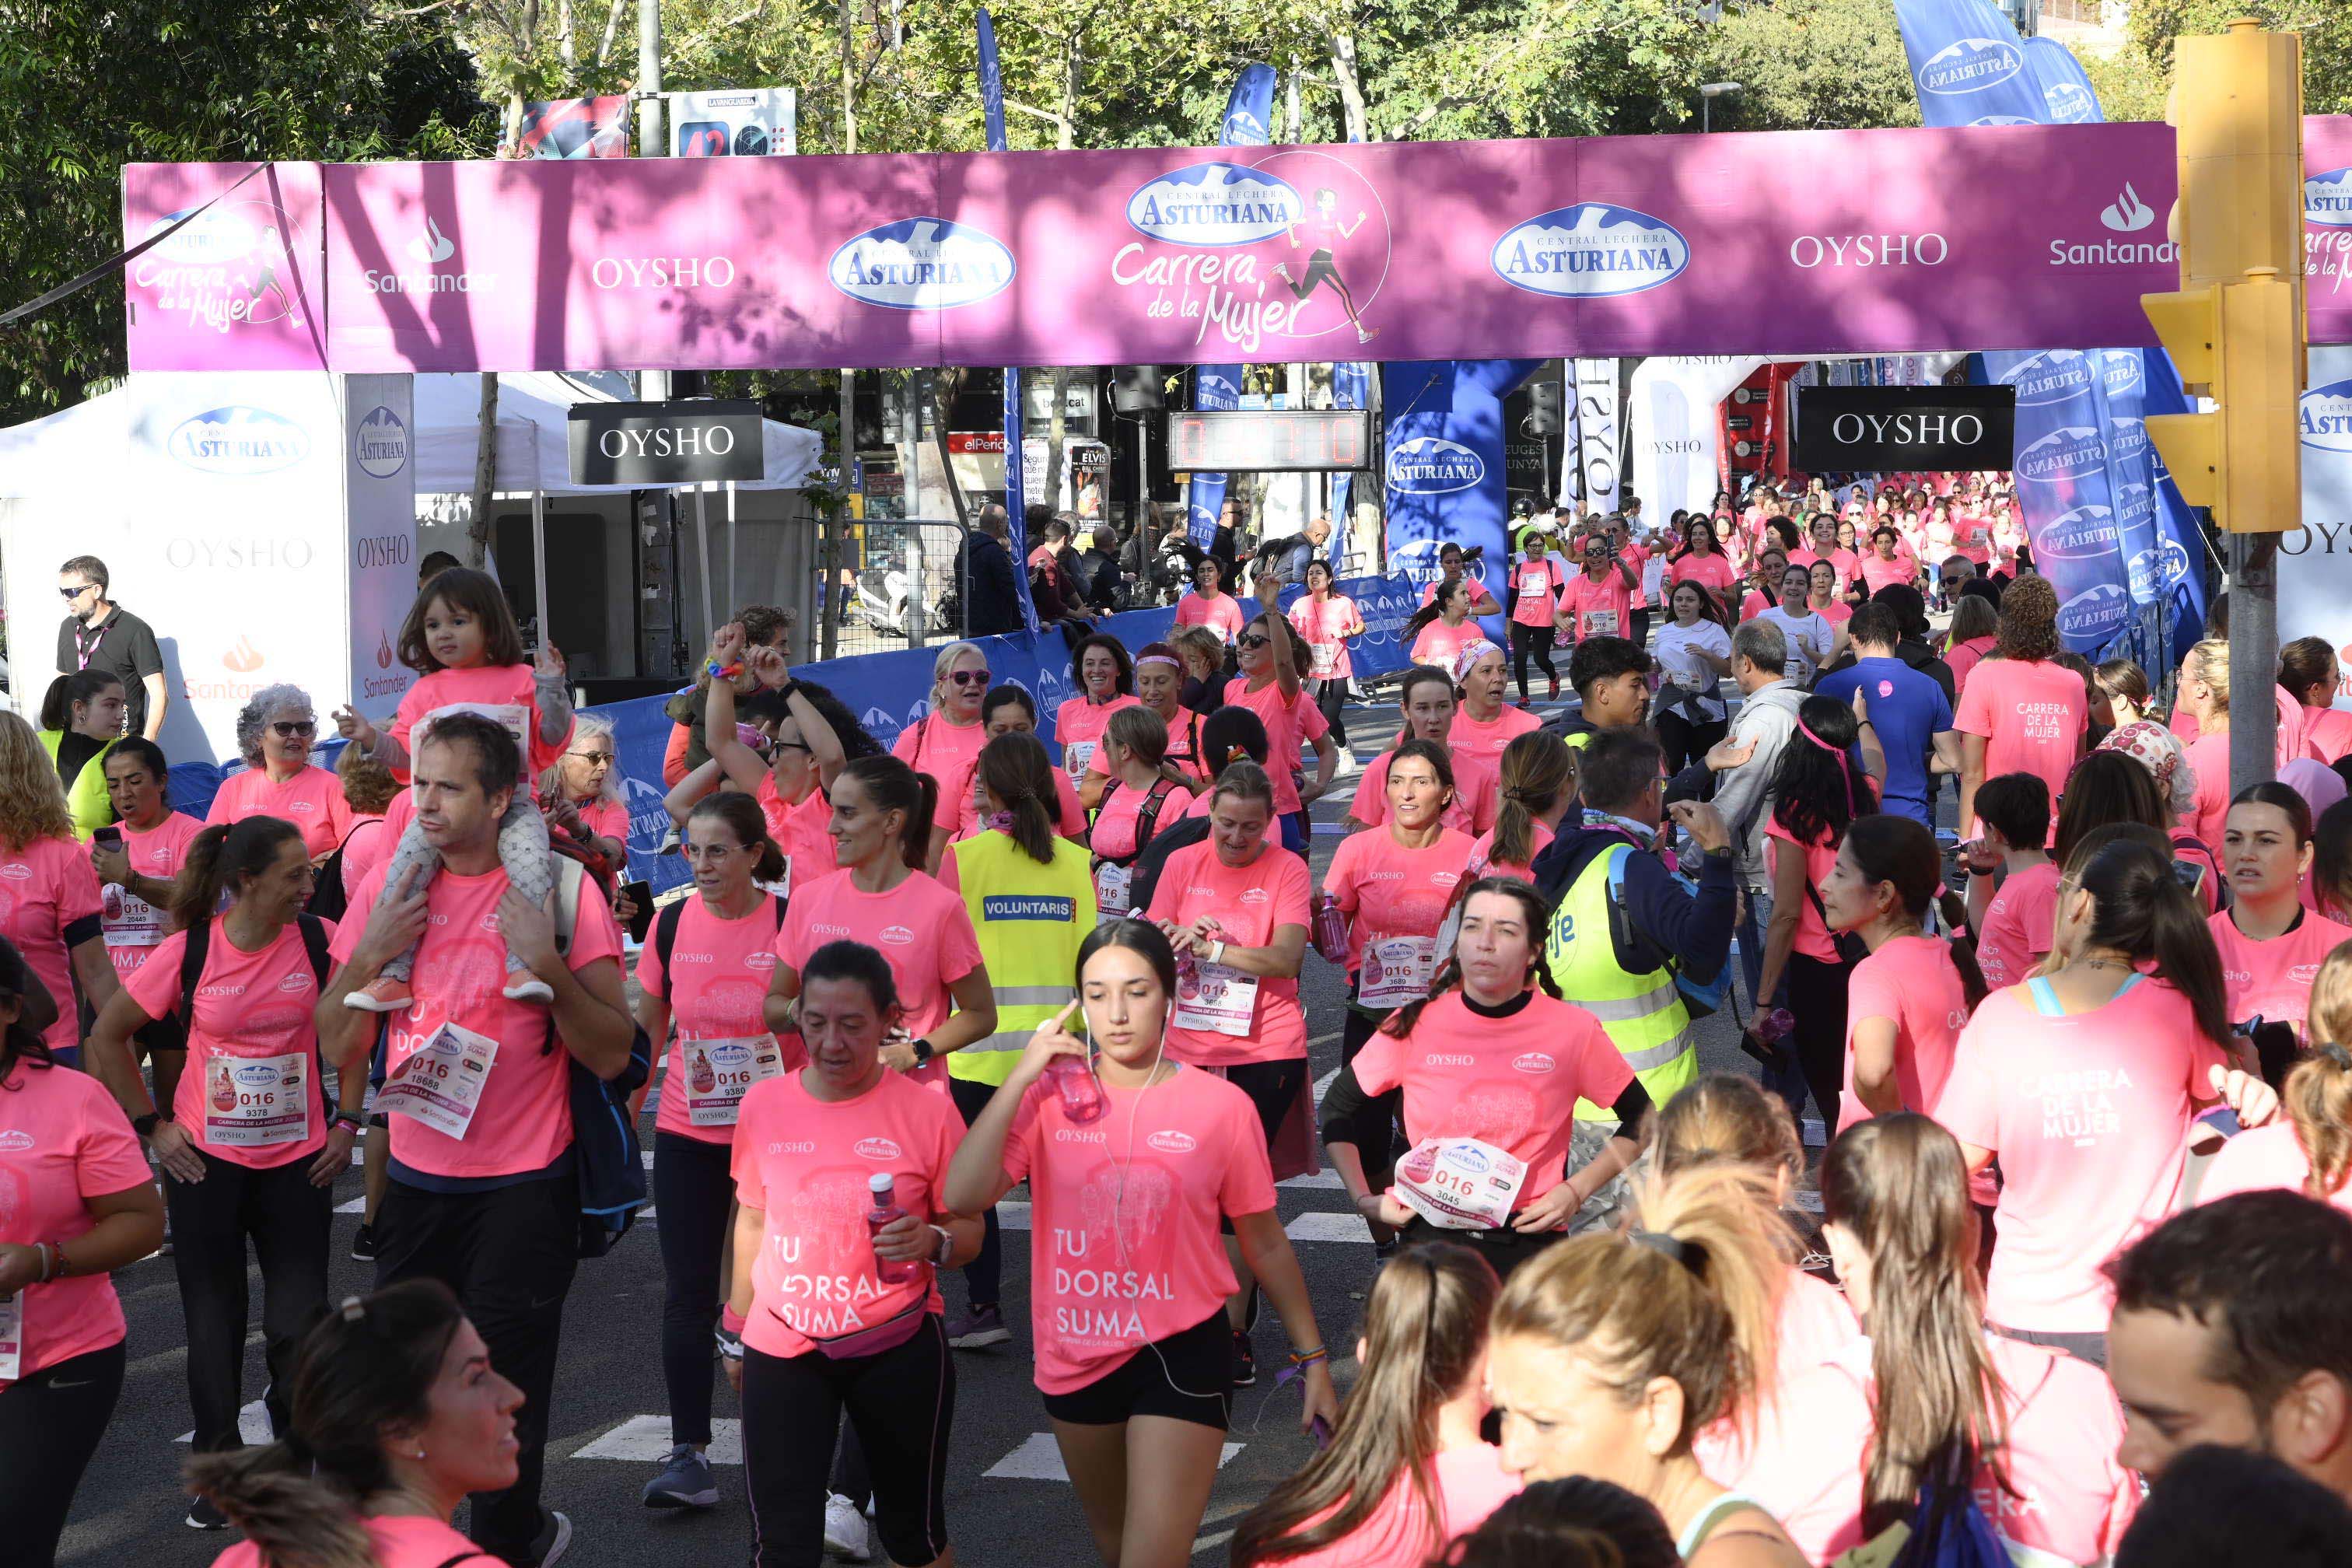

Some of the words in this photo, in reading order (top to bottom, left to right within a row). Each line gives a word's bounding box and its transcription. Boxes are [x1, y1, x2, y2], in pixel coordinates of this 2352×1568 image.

[1228, 189, 1284, 199] LECHERA
[1140, 194, 1289, 226] ASTURIANA
[1538, 236, 1596, 247] CENTRAL
[1605, 234, 1668, 244] LECHERA
[1506, 240, 1674, 275] ASTURIANA
[1790, 233, 1948, 267] OYSHO
[845, 251, 1001, 285] ASTURIANA
[1111, 243, 1257, 285] Carrera
[2322, 253, 2336, 275] la
[135, 261, 227, 287] Carrera
[592, 257, 735, 289] OYSHO
[363, 270, 499, 293] Santander
[158, 292, 175, 309] de
[177, 293, 191, 309] la
[189, 291, 261, 334] Mujer
[1147, 286, 1174, 317] de
[1180, 286, 1199, 317] la
[1195, 279, 1312, 353] Mujer
[1832, 413, 1983, 445] OYSHO
[184, 432, 300, 457] ASTURIANA
[359, 433, 404, 460] ASTURIANA
[600, 425, 734, 459] OYSHO
[1642, 439, 1702, 455] OYSHO
[1082, 453, 1106, 463] ELVIS
[1389, 462, 1477, 482] ASTURIANA
[166, 536, 313, 568] OYSHO
[358, 534, 408, 569] OYSHO
[364, 673, 408, 698] Santander
[2016, 702, 2070, 715] CARRERA
[2027, 714, 2042, 726] DE
[2045, 715, 2059, 726] LA
[2024, 726, 2060, 738] MUJER
[1370, 870, 1405, 881] OYSHO
[1099, 887, 1118, 898] 016
[1187, 885, 1214, 897] OYSHO
[124, 903, 149, 914] 016
[986, 901, 1069, 915] VOLUNTARIS
[811, 922, 850, 936] OYSHO
[674, 952, 713, 964] OYSHO
[1384, 965, 1412, 977] 016
[201, 985, 246, 996] OYSHO
[1202, 984, 1229, 997] 016
[1181, 1016, 1202, 1025] OYSHO
[413, 1057, 450, 1078] 016
[1426, 1053, 1475, 1066] OYSHO
[1515, 1060, 1553, 1070] ASTURIANA
[239, 1073, 275, 1082] ASTURIANA
[411, 1074, 440, 1090] 18688
[718, 1071, 751, 1085] 016
[2020, 1067, 2133, 1098] CARRERA
[240, 1092, 275, 1105] 016
[724, 1087, 746, 1096] 9380
[246, 1108, 268, 1117] 9378
[2042, 1096, 2075, 1117] DE
[2083, 1094, 2114, 1112] LA
[698, 1111, 728, 1120] OYSHO
[2043, 1113, 2122, 1139] MUJER
[214, 1131, 246, 1139] OYSHO
[1055, 1129, 1107, 1144] OYSHO
[1151, 1136, 1194, 1149] ASTURIANA
[768, 1141, 816, 1154] OYSHO
[1447, 1151, 1486, 1171] ASTURIANA
[1436, 1170, 1474, 1195] 016
[1436, 1189, 1460, 1206] 3045
[1442, 1205, 1452, 1213] LA
[1055, 1228, 1087, 1257] TU
[1055, 1268, 1174, 1300] DORSAL
[781, 1302, 864, 1332] SUMA
[1056, 1307, 1146, 1337] SUMA
